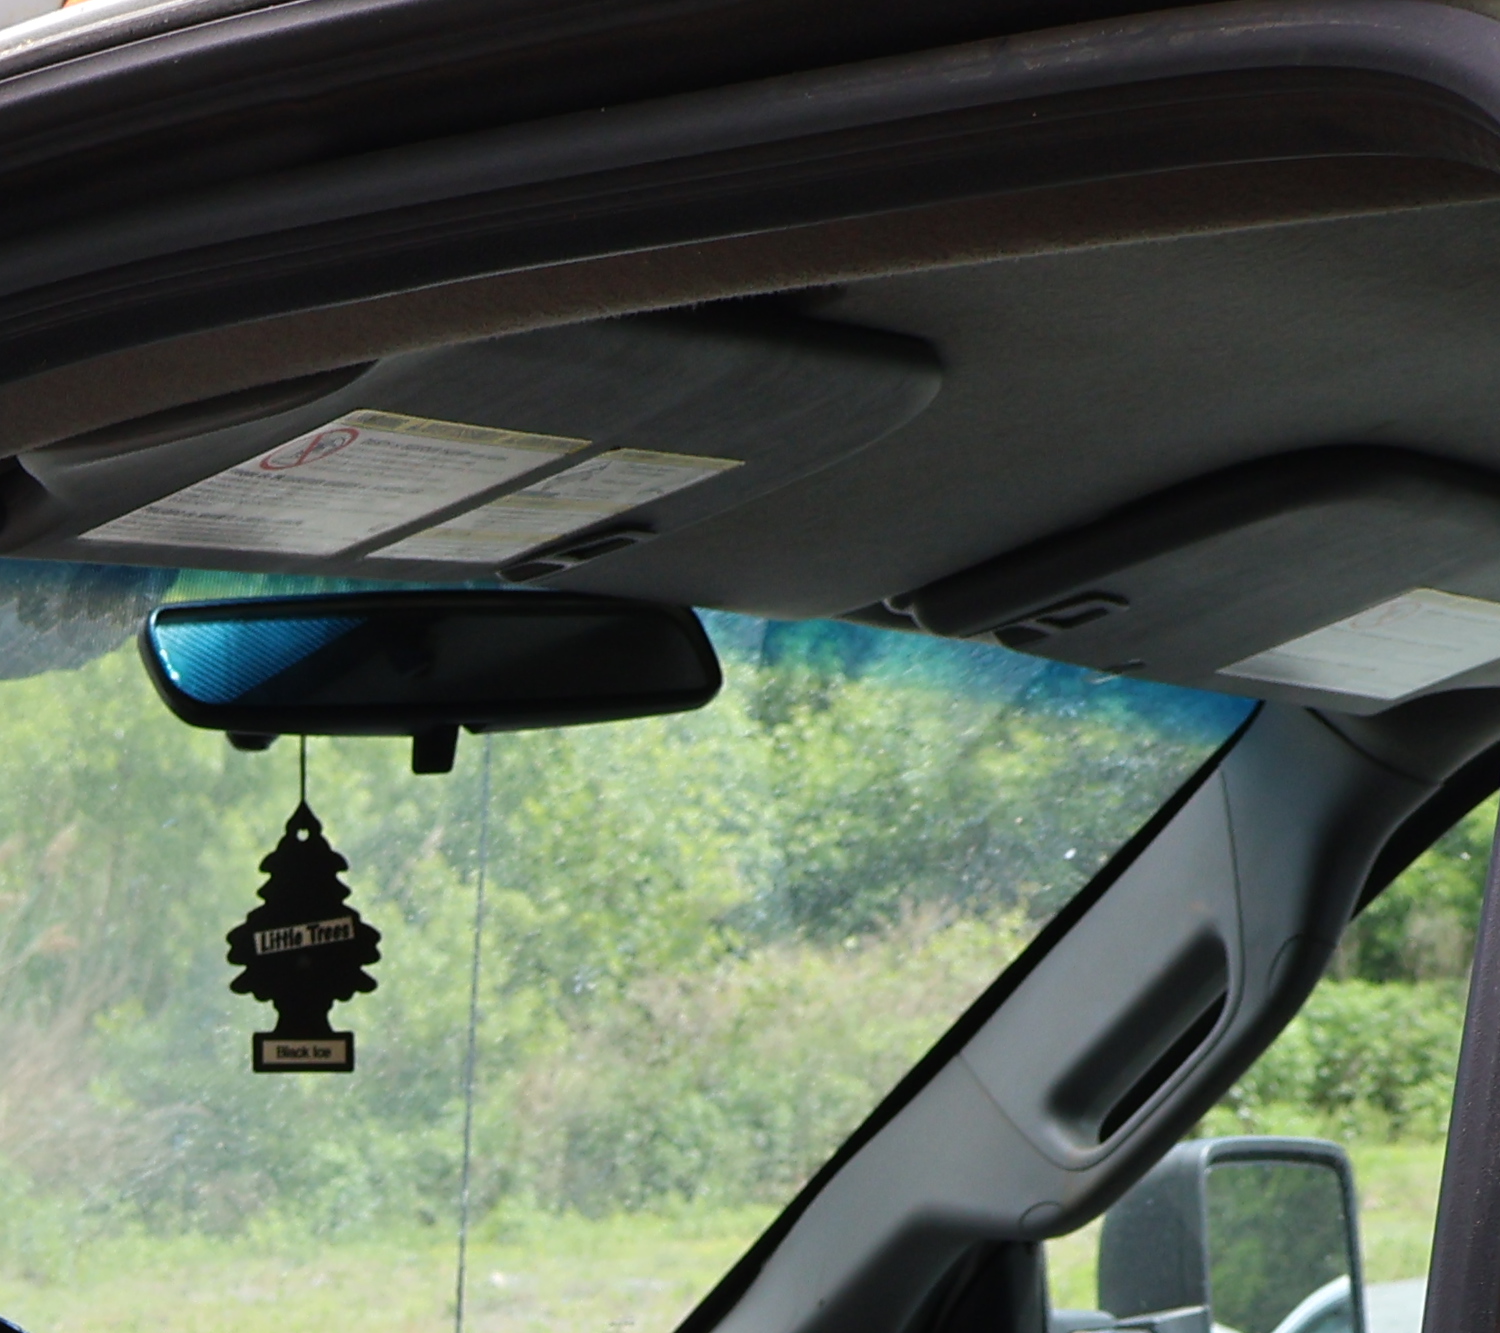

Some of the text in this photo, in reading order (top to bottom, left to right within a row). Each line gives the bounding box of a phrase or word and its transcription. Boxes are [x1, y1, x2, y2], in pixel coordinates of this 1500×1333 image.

[260, 922, 350, 952] Little Trees
[276, 1045, 332, 1059] Black Ice
